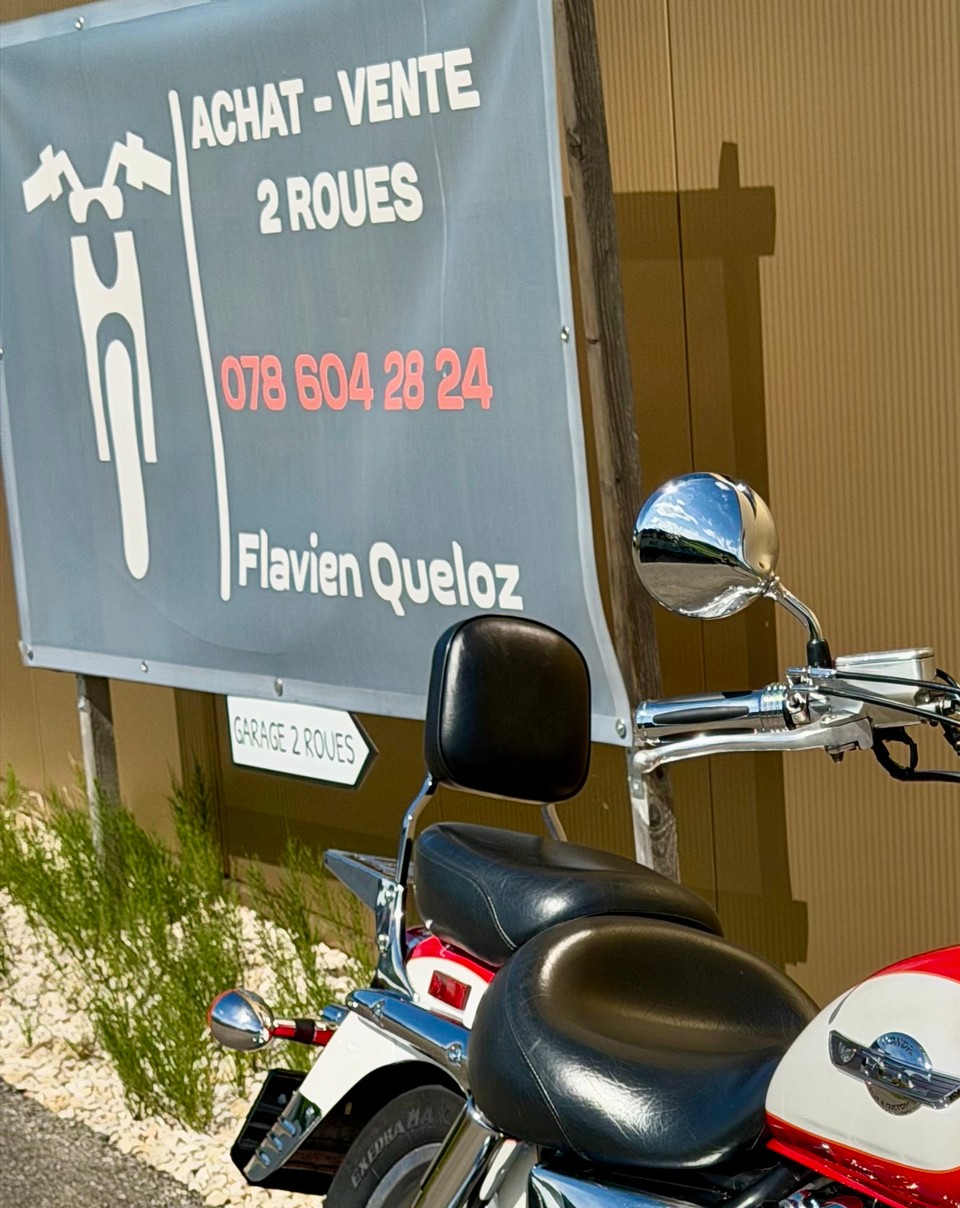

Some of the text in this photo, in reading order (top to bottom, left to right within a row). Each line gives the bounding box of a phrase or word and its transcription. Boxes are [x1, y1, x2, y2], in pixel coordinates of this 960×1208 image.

[192, 78, 304, 149] ACHAT
[337, 47, 481, 126] VENTE
[257, 161, 423, 234] 2 ROUES
[221, 347, 493, 411] 078 604 28 24
[238, 528, 524, 616] Flavien Queloz
[233, 715, 356, 765] GARAGE 2 ROUES
[350, 1119, 406, 1190] EXEDRA
